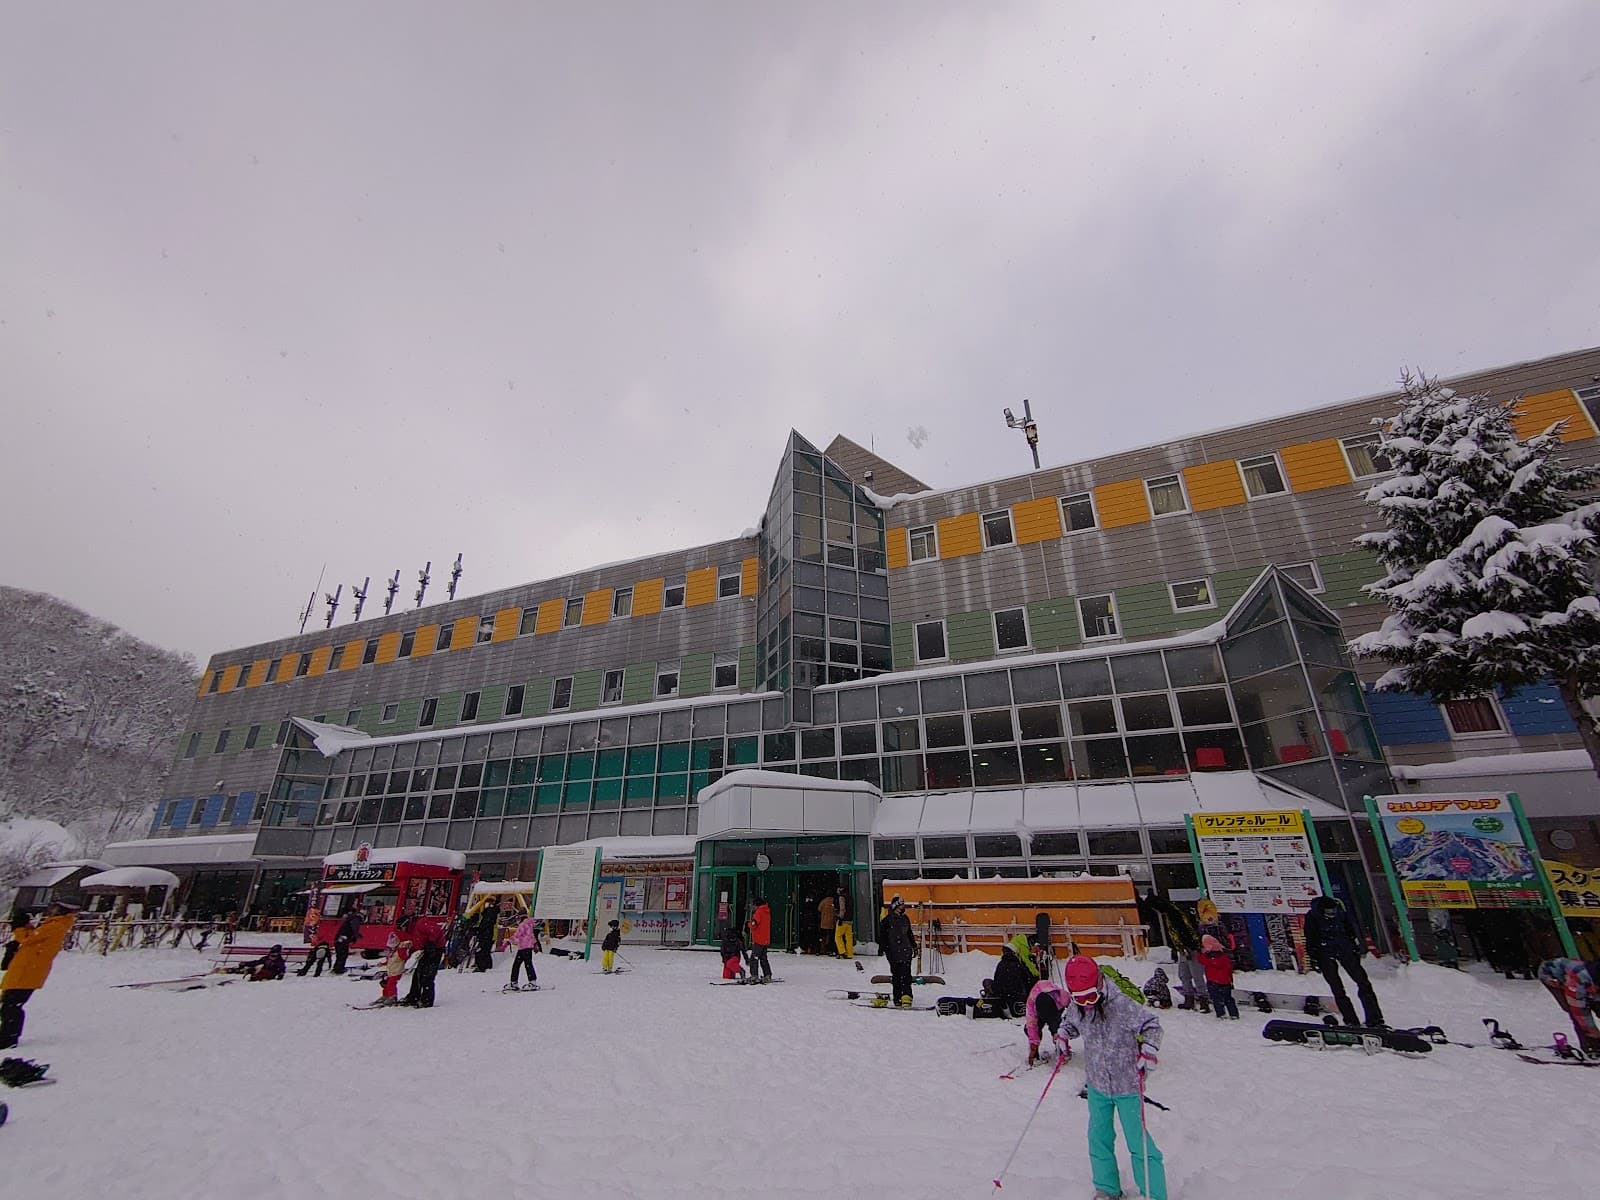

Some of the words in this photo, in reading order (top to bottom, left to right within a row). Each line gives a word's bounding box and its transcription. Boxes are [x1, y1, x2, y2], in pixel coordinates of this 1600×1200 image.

[1205, 814, 1291, 827] ゲレンデのルール
[1557, 889, 1600, 907] 集合
